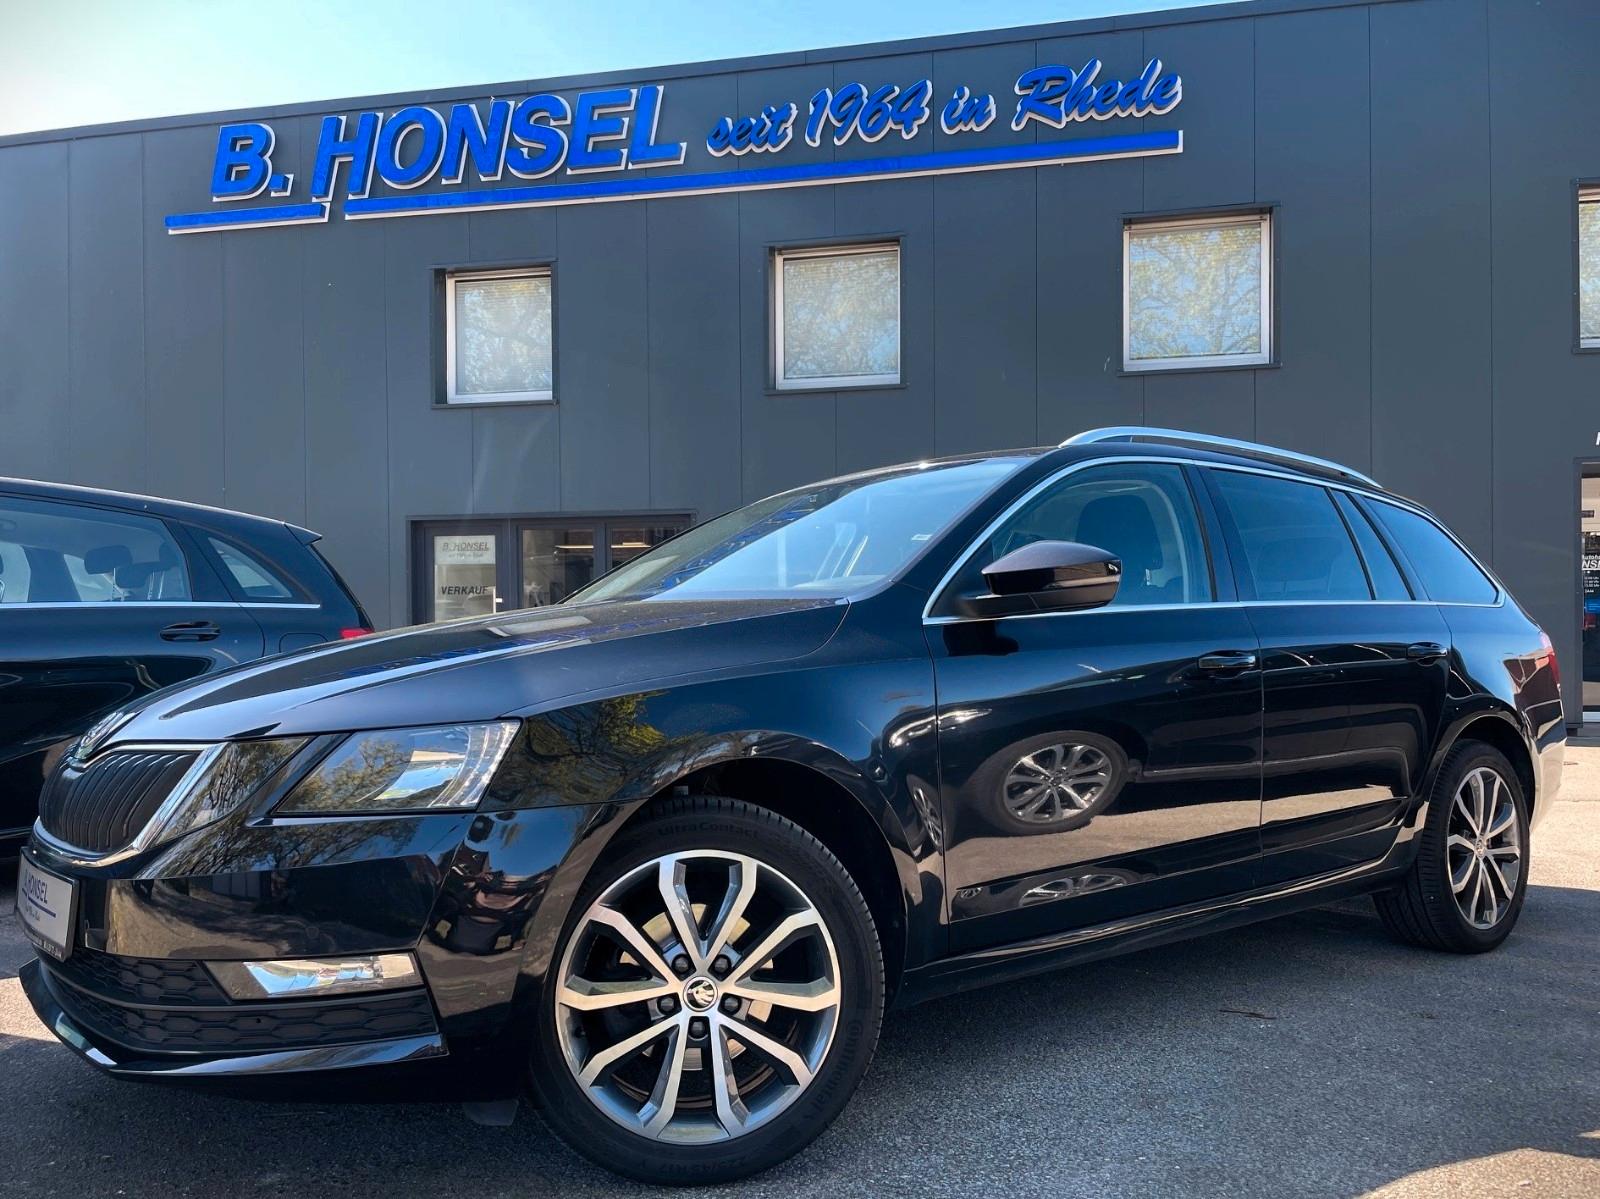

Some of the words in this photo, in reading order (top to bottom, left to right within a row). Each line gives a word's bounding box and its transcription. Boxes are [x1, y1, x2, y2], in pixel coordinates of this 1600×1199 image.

[211, 123, 294, 202] B.
[310, 84, 687, 203] HONSEL
[707, 102, 798, 157] seit
[804, 79, 933, 147] 1964
[941, 86, 998, 135] in
[1011, 57, 1183, 131] Rhede
[441, 585, 488, 595] VERKAUF
